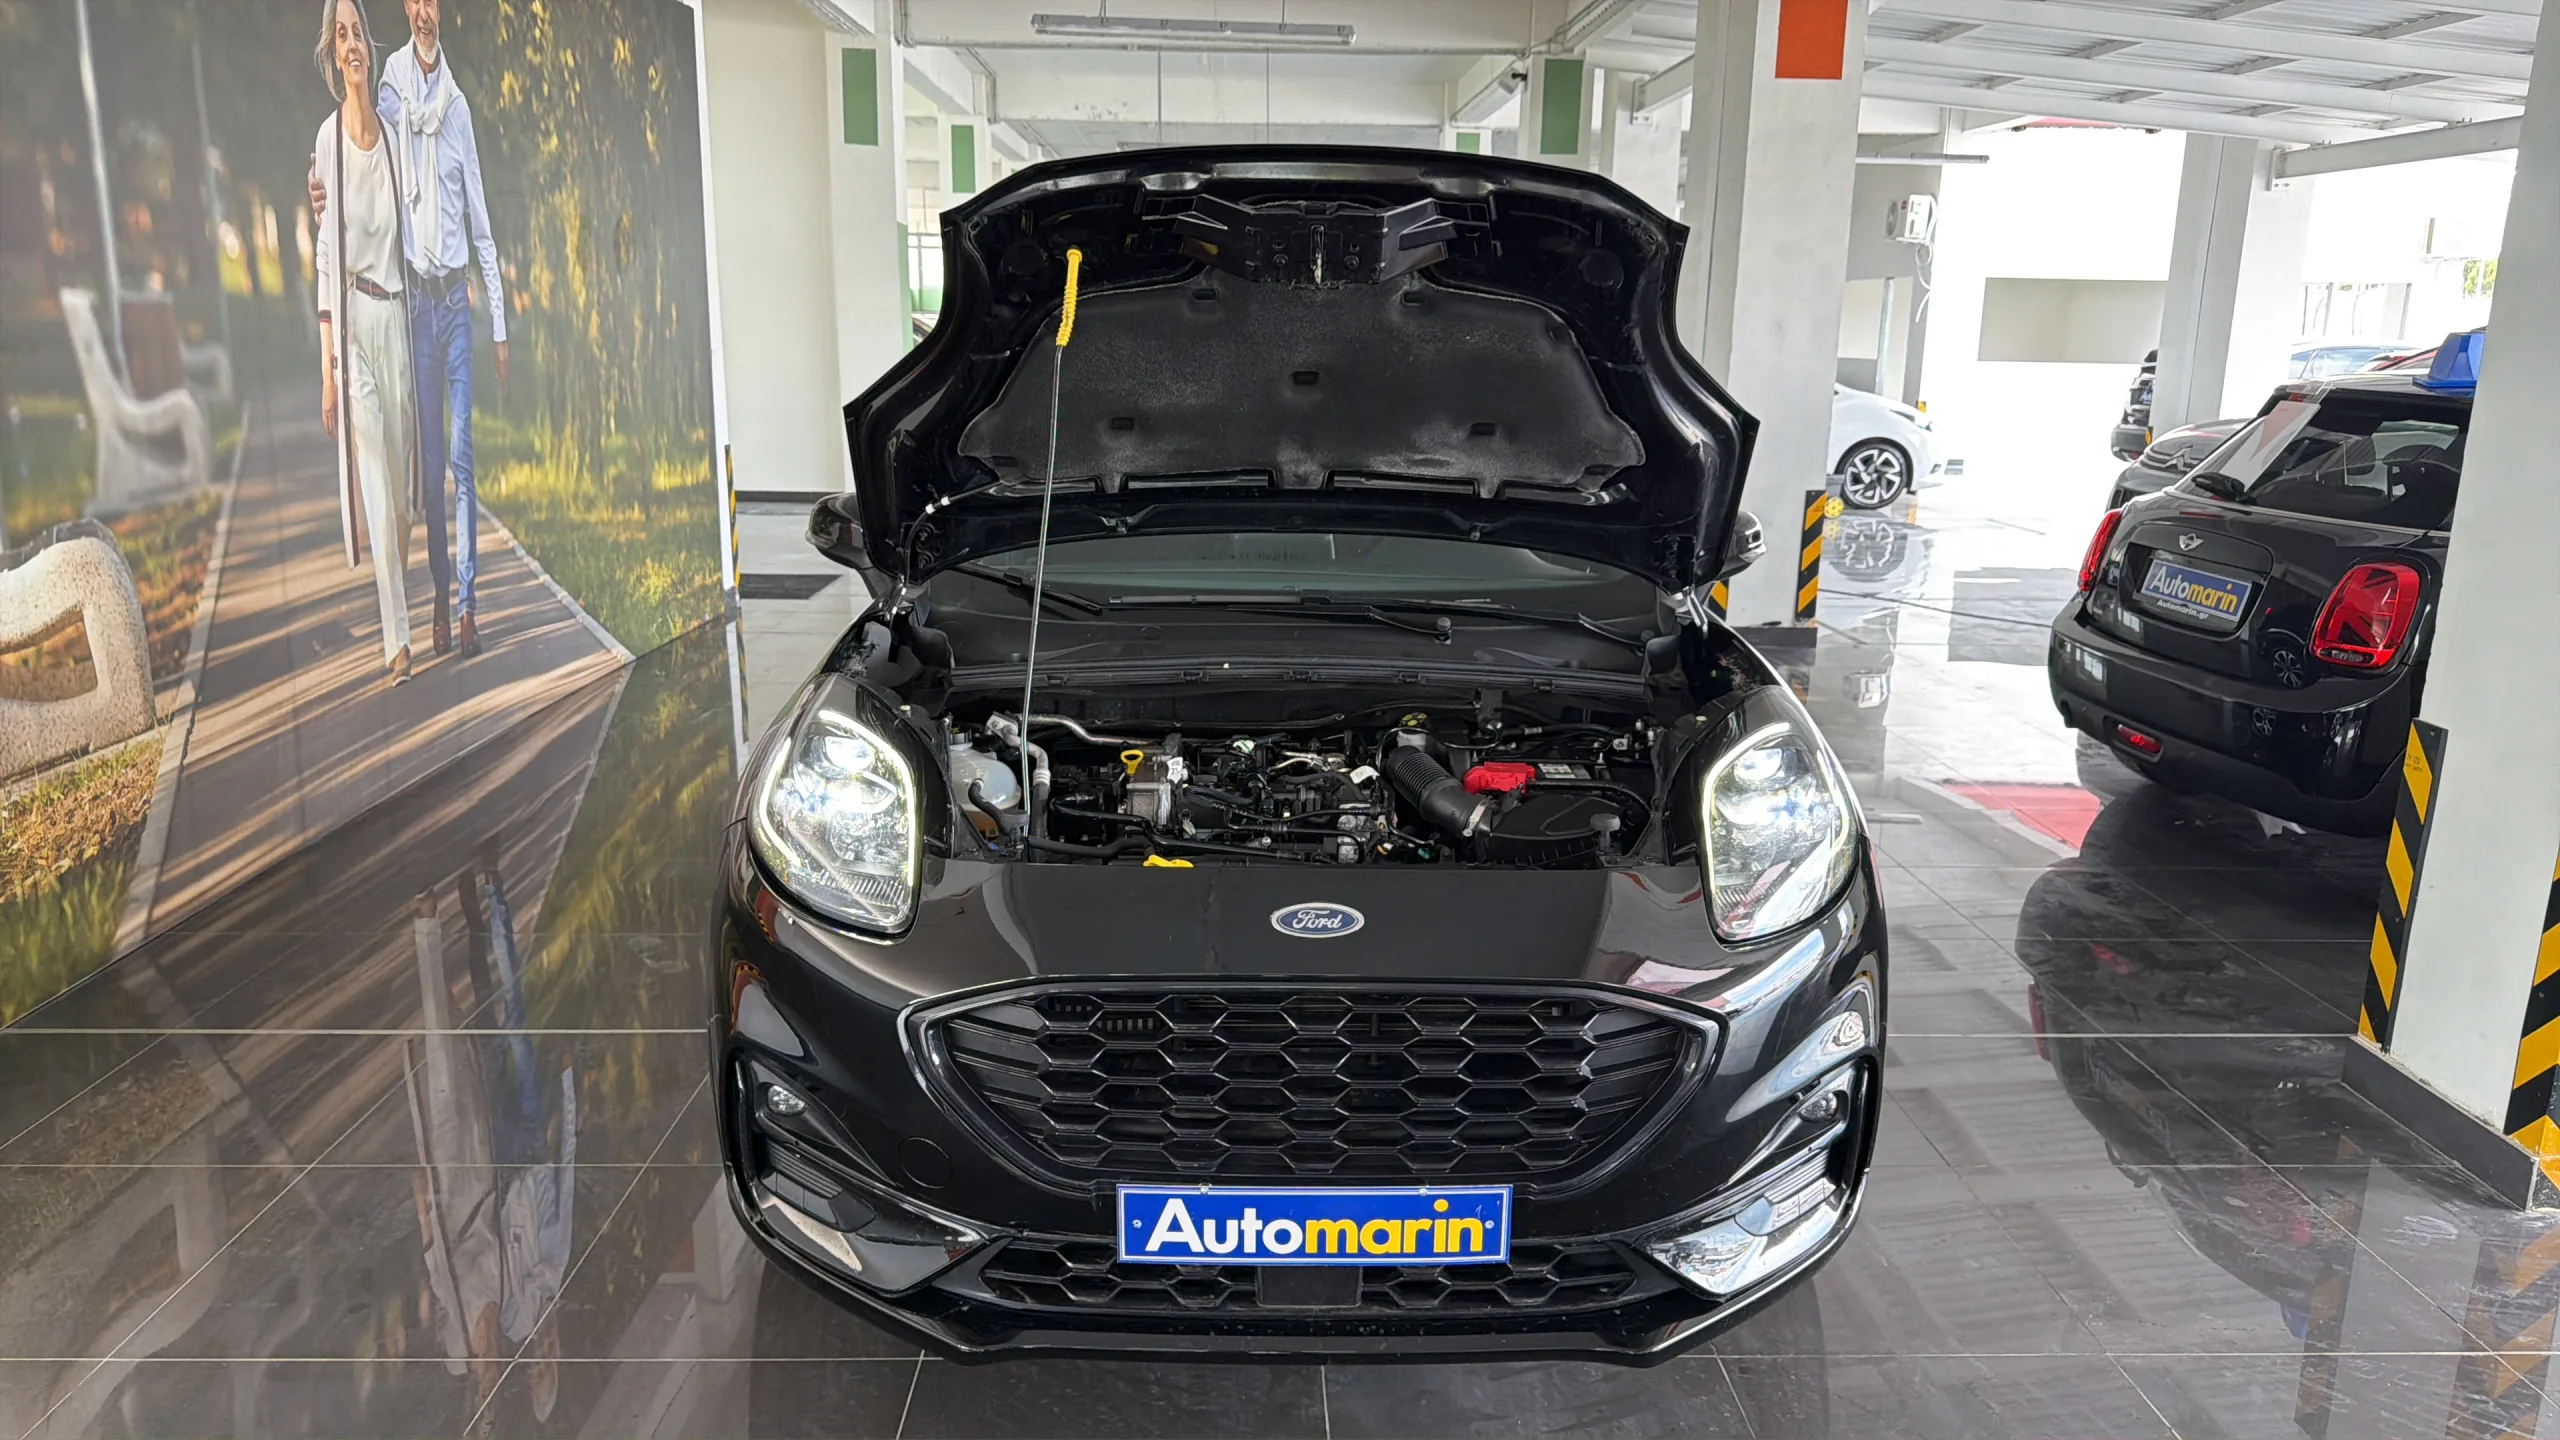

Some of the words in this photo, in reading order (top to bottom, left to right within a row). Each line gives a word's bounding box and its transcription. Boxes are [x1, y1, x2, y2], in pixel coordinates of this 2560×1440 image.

[2149, 566, 2238, 613] Automarin
[2157, 599, 2209, 619] Automarin.gr
[1292, 909, 1343, 929] Ford
[1145, 1198, 1484, 1254] Automarin
